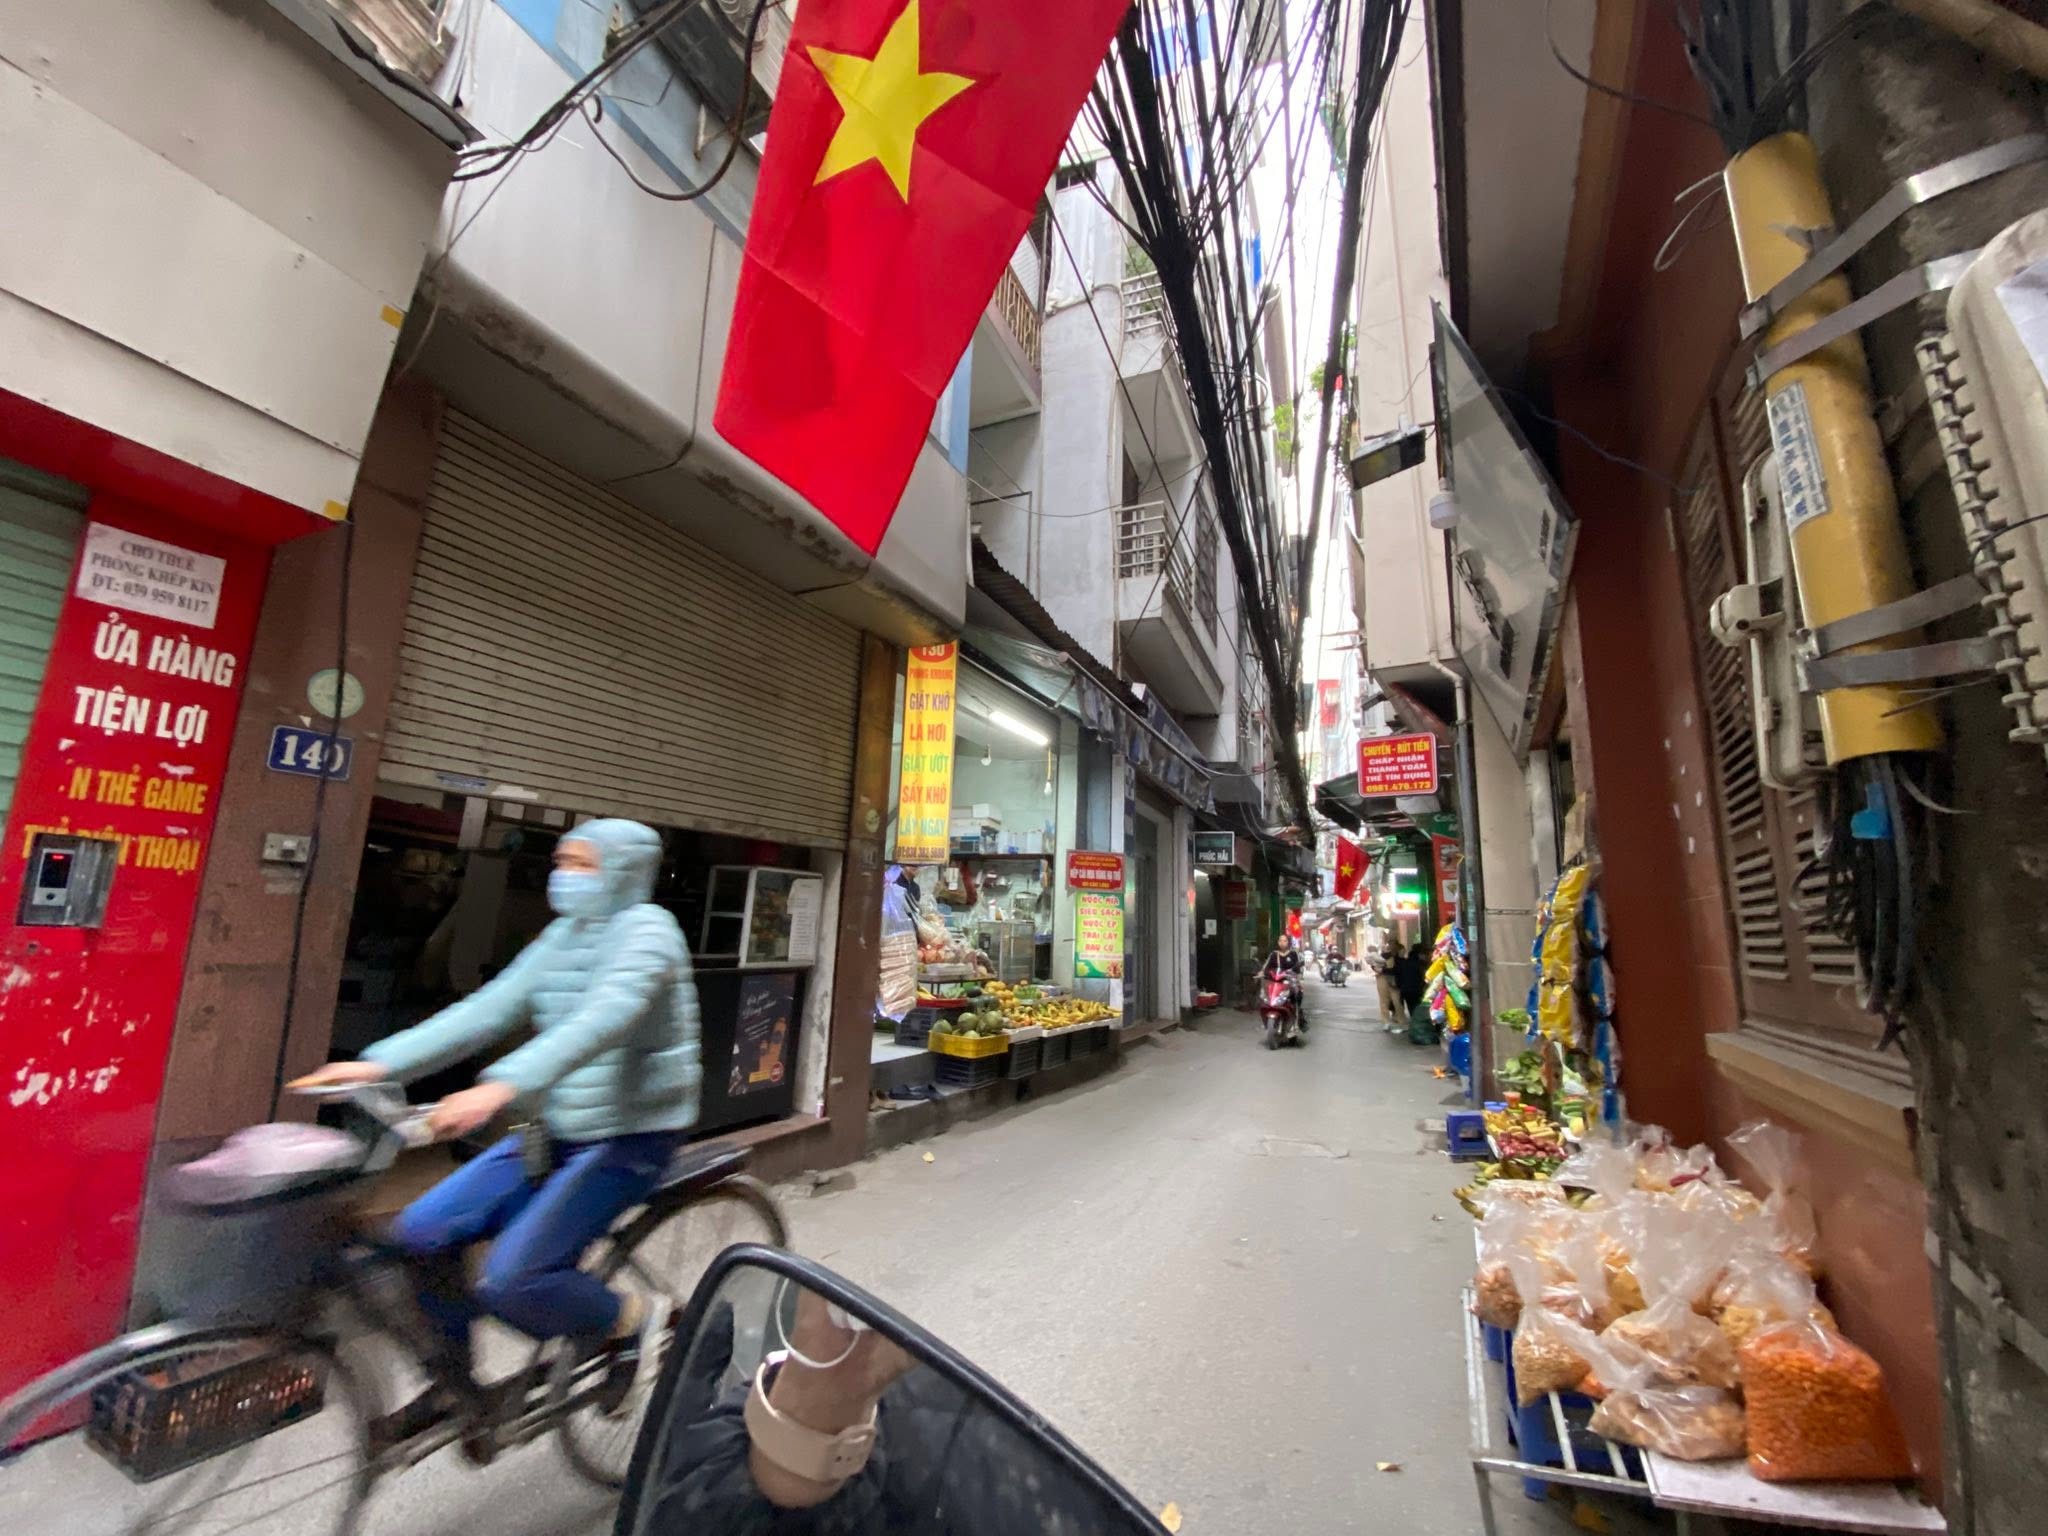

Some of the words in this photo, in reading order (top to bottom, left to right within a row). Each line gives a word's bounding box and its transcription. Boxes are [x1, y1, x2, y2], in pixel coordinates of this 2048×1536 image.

[121, 541, 154, 560] CHO
[147, 634, 236, 688] HÀNG
[74, 685, 151, 736] TIỆN
[155, 702, 209, 748] LỢI
[96, 764, 141, 807] THẺ
[143, 777, 209, 815] GAME
[1368, 765, 1399, 774] THANH
[1401, 763, 1427, 771] TOÁN
[135, 835, 201, 875] THOẠI
